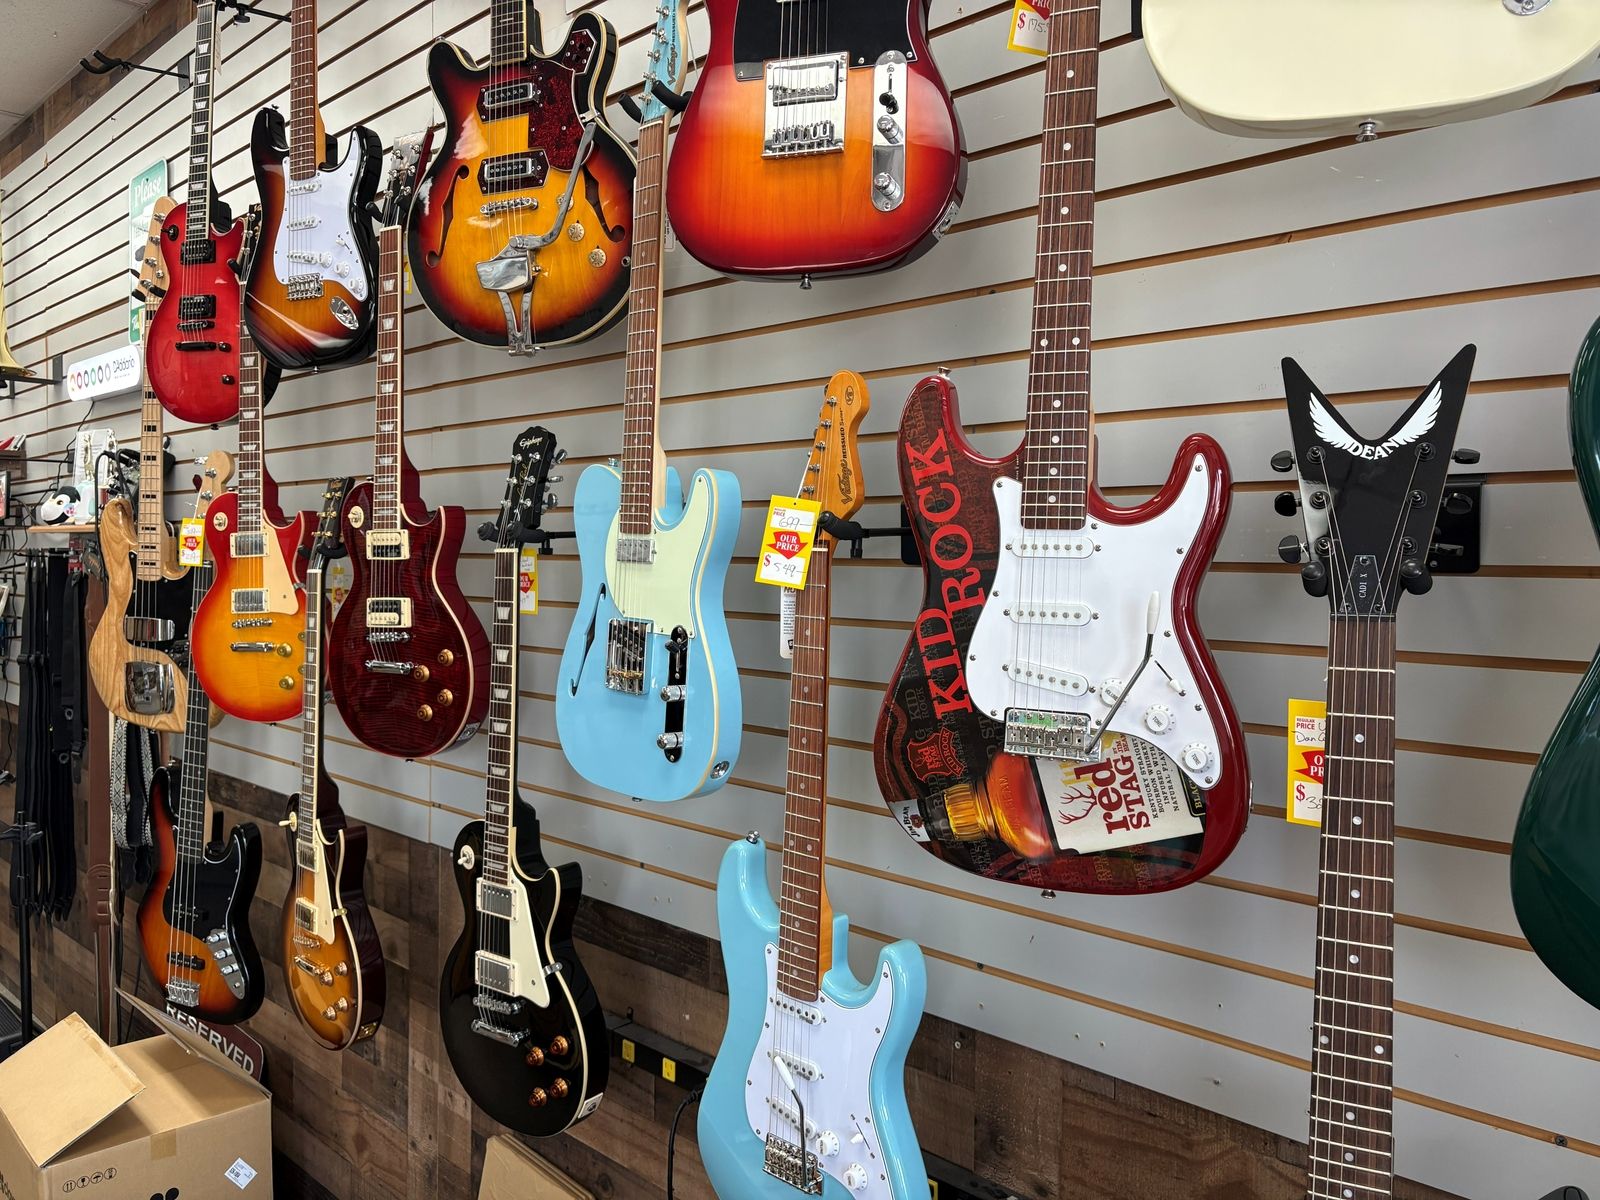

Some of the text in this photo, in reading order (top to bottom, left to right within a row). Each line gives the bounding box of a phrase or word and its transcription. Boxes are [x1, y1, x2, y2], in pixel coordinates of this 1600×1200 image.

[134, 175, 162, 207] Please
[1349, 438, 1401, 460] DEAN
[838, 459, 853, 504] Vintage
[780, 534, 797, 543] OUR
[905, 428, 986, 619] ROCK
[764, 554, 772, 567] $
[776, 542, 800, 552] PRICE
[915, 608, 974, 720] KID
[1296, 722, 1316, 731] PRICE
[924, 744, 935, 769] red
[942, 731, 952, 757] ROCK
[1116, 740, 1124, 753] JIM
[948, 756, 962, 774] KID
[1131, 738, 1159, 819] KENTUCKY STRAIGHT
[1139, 740, 1165, 813] BOURBON WHISKEY
[1073, 757, 1131, 834] red
[1113, 755, 1151, 830] STAG
[1156, 769, 1170, 805] INFUSED
[1164, 774, 1180, 812] NATURAL
[1187, 778, 1203, 809] BLAC
[1296, 783, 1305, 801] $
[908, 825, 920, 838] JIM
[166, 1002, 255, 1077] RESERVED
